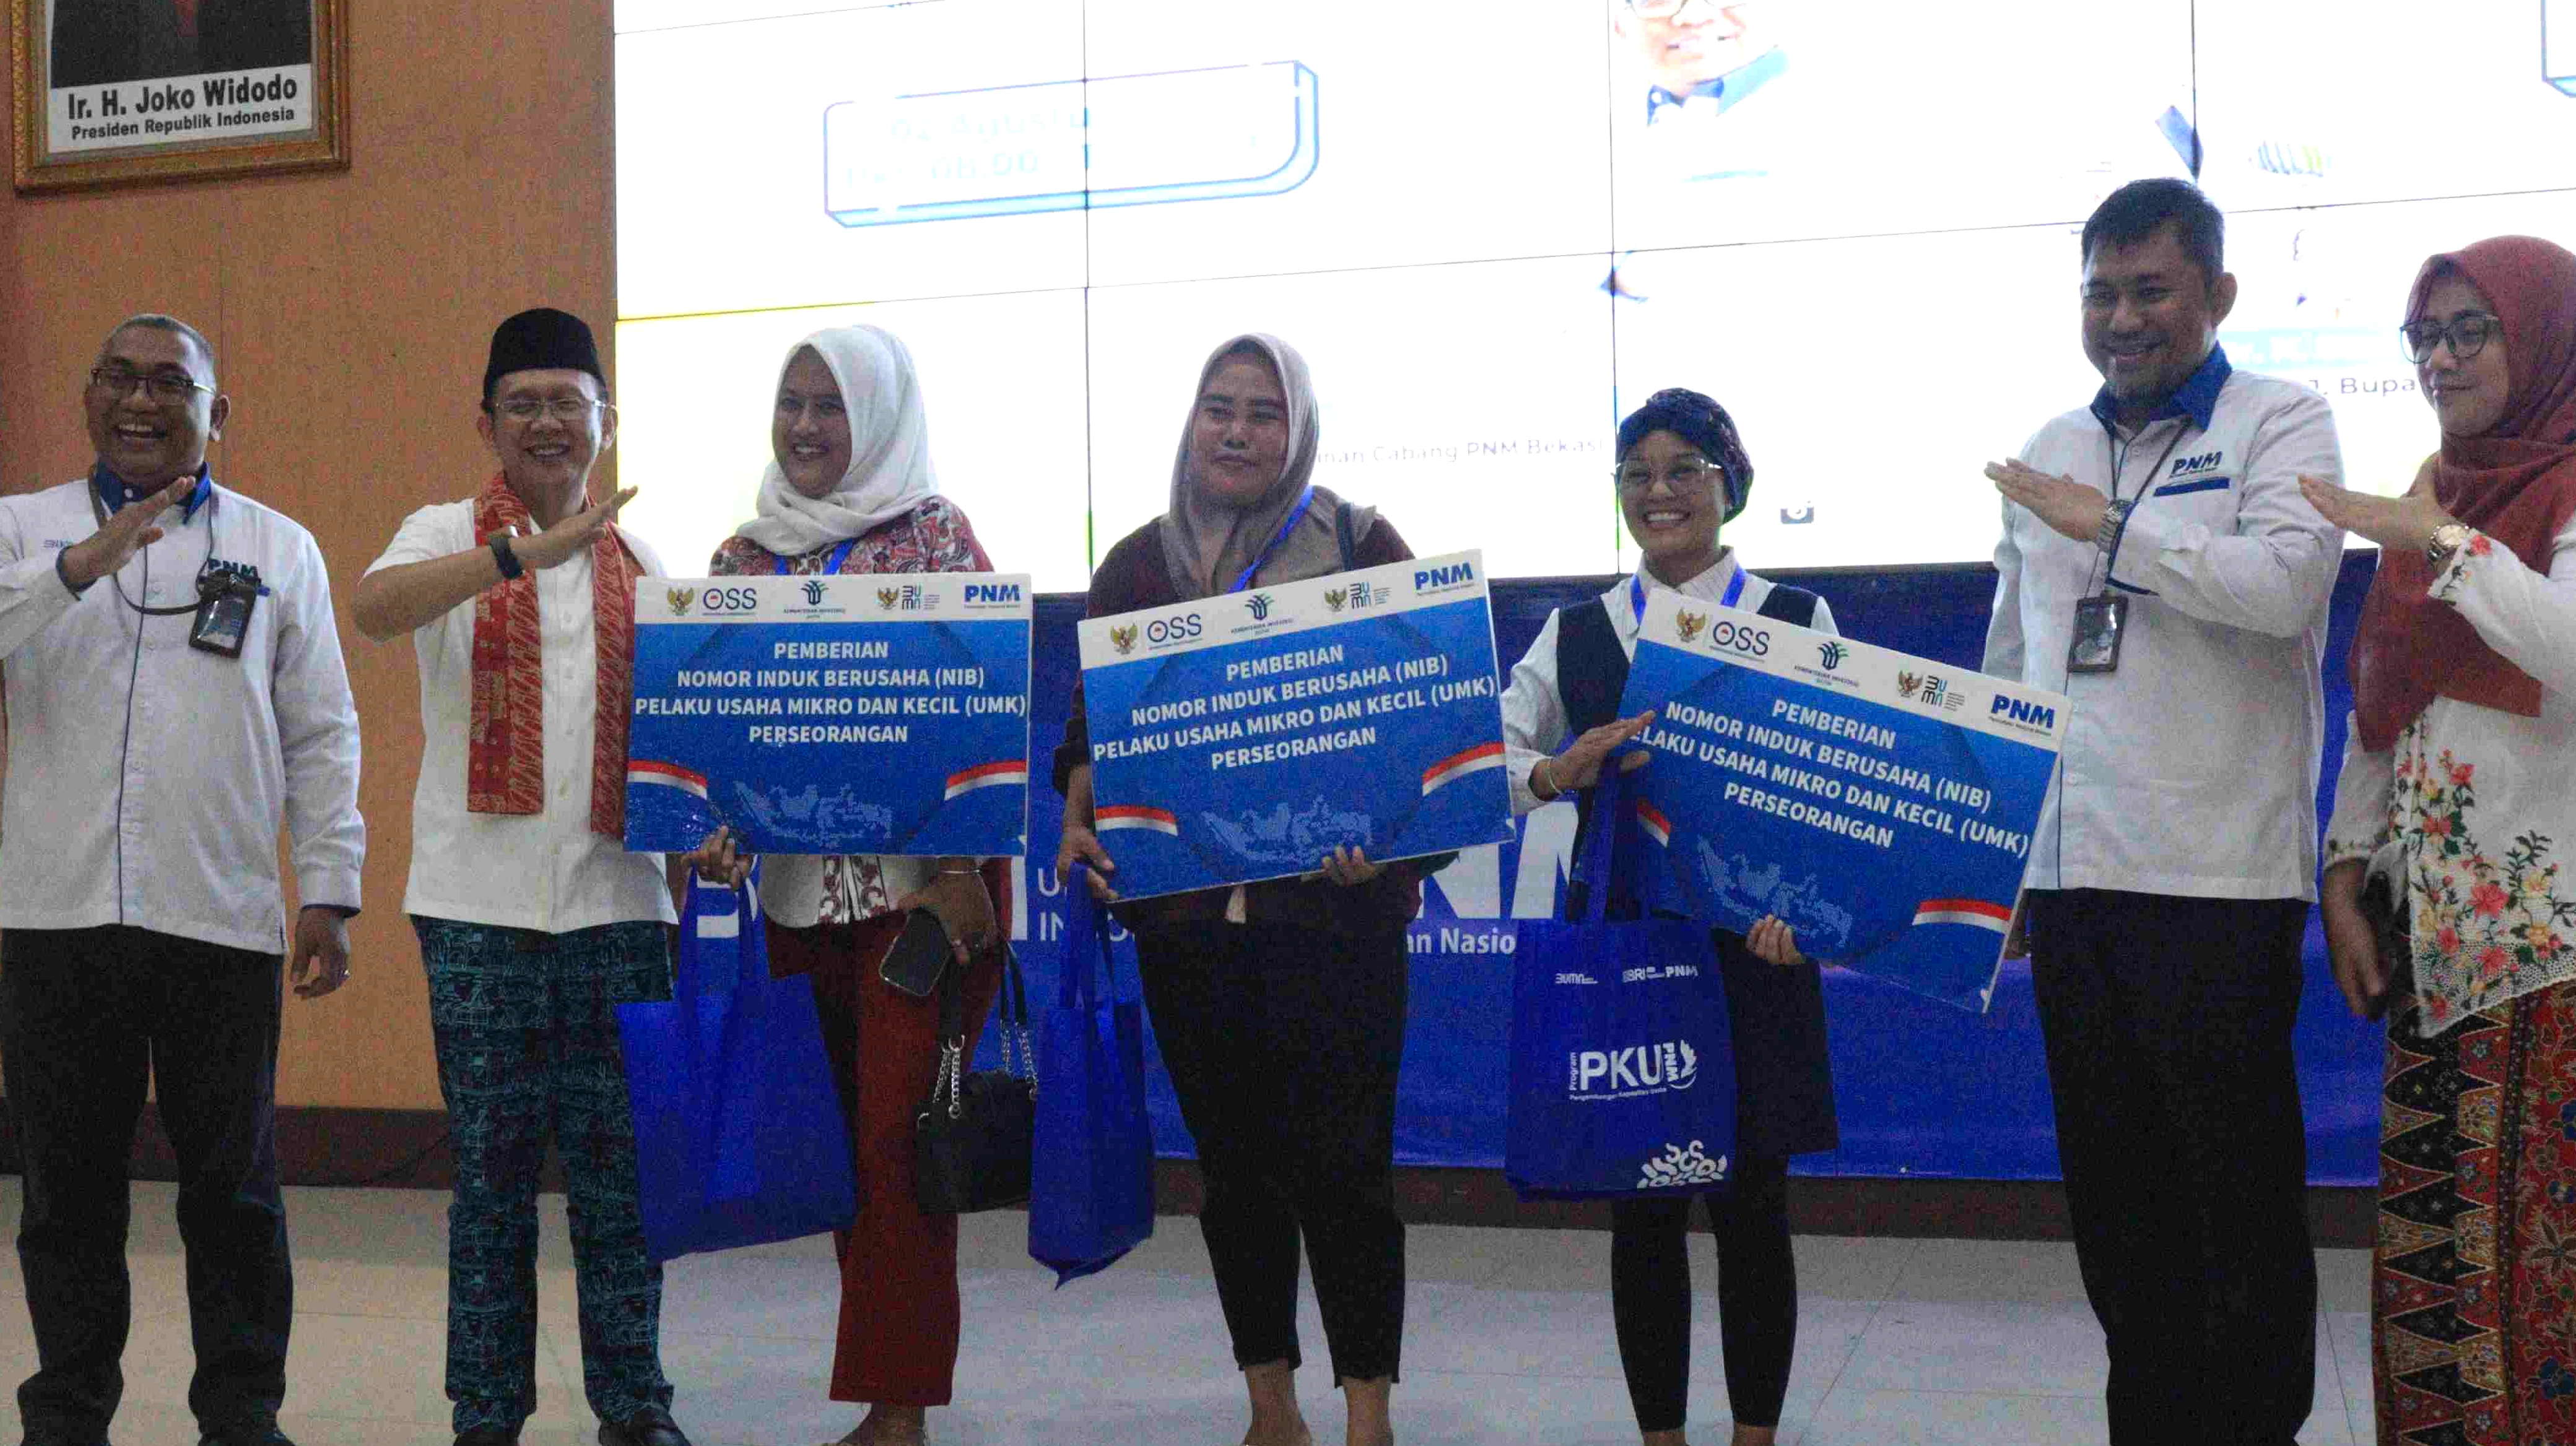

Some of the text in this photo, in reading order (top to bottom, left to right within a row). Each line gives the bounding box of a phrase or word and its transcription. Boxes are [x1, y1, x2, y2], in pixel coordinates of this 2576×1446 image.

[68, 73, 298, 120] Ir. H. Joko Widodo
[71, 107, 295, 140] Presiden Republik Indonesia
[1372, 443, 1458, 463] Cabang
[1466, 440, 1519, 456] PNM
[2171, 451, 2224, 474] PNM
[1414, 560, 1474, 591] PNM
[703, 587, 757, 611] OSS
[964, 584, 1022, 603] PNM
[1147, 613, 1203, 643] OSS
[1712, 621, 1770, 656] OSS
[774, 642, 889, 660] PEMBERIAN
[1226, 644, 1344, 682] PEMBERIAN
[677, 667, 985, 689] NOMOR INDUK BERUSAHA (NIB)
[1132, 654, 1448, 726] NOMOR INDUK BERUSAHA (NIB)
[635, 695, 1026, 716] PELAKU USAHA MIKRO DAN KECIL (UMK)
[1093, 676, 1495, 761] PELAKU USAHA MIKRO DAN KECIL (UMK)
[1990, 693, 2056, 729] PNM
[749, 725, 908, 743] PERSEORANGAN
[1772, 699, 1896, 749] PEMBERIAN
[1211, 726, 1377, 770] PERSEORANGAN
[1666, 701, 1991, 814] NOMOR INDUK BERUSAHA (NIB)
[1629, 725, 2029, 859] LAKU USAHA MIKRO DAN KECIL (UMK)
[1724, 782, 1894, 848] PERSEORANGAN
[1665, 965, 1699, 977] PNM
[1580, 1044, 1663, 1091] PKU
